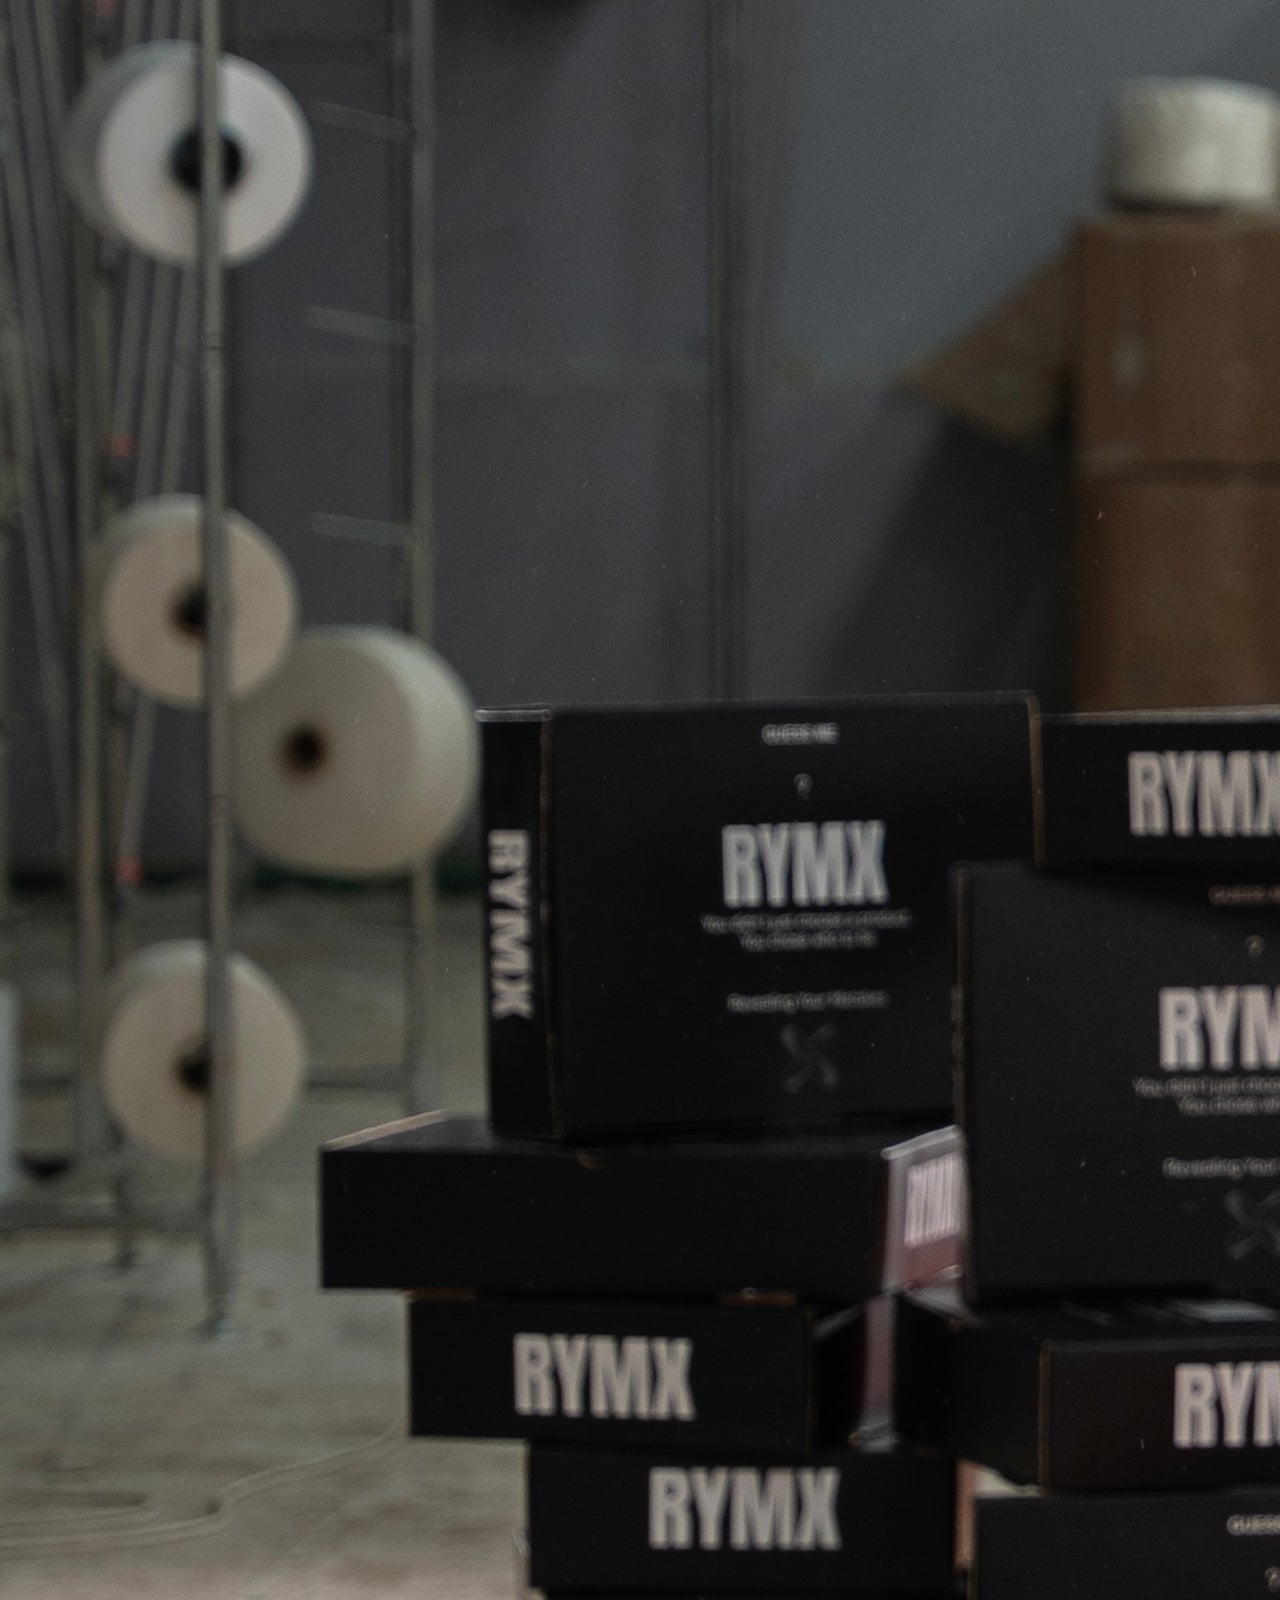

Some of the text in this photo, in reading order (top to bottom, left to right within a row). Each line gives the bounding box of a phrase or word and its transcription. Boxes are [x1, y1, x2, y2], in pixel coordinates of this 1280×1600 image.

[722, 820, 888, 907] RYMX
[489, 829, 533, 1019] RYMX
[514, 1333, 695, 1421] RYMX
[649, 1467, 840, 1550] RYMX
